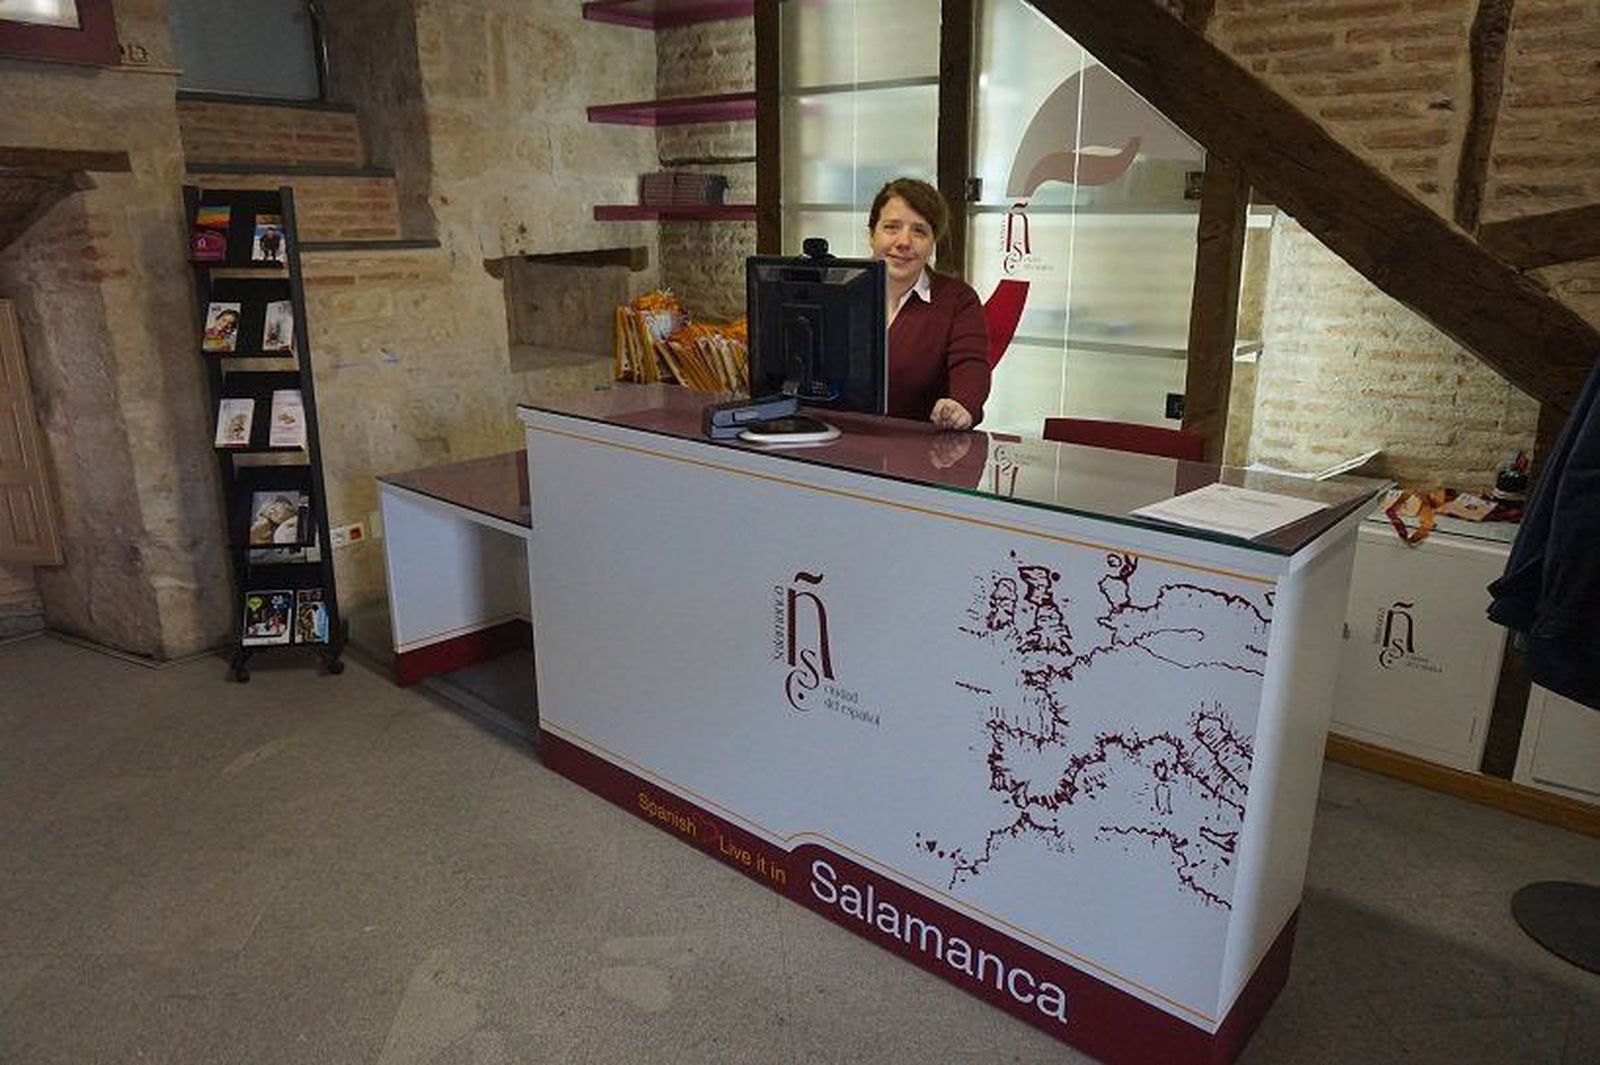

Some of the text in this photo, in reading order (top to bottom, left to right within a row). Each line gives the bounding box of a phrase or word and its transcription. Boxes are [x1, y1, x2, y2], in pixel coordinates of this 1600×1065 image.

[638, 792, 787, 884] Spanish Live it in
[810, 859, 1068, 1024] Salamanca
